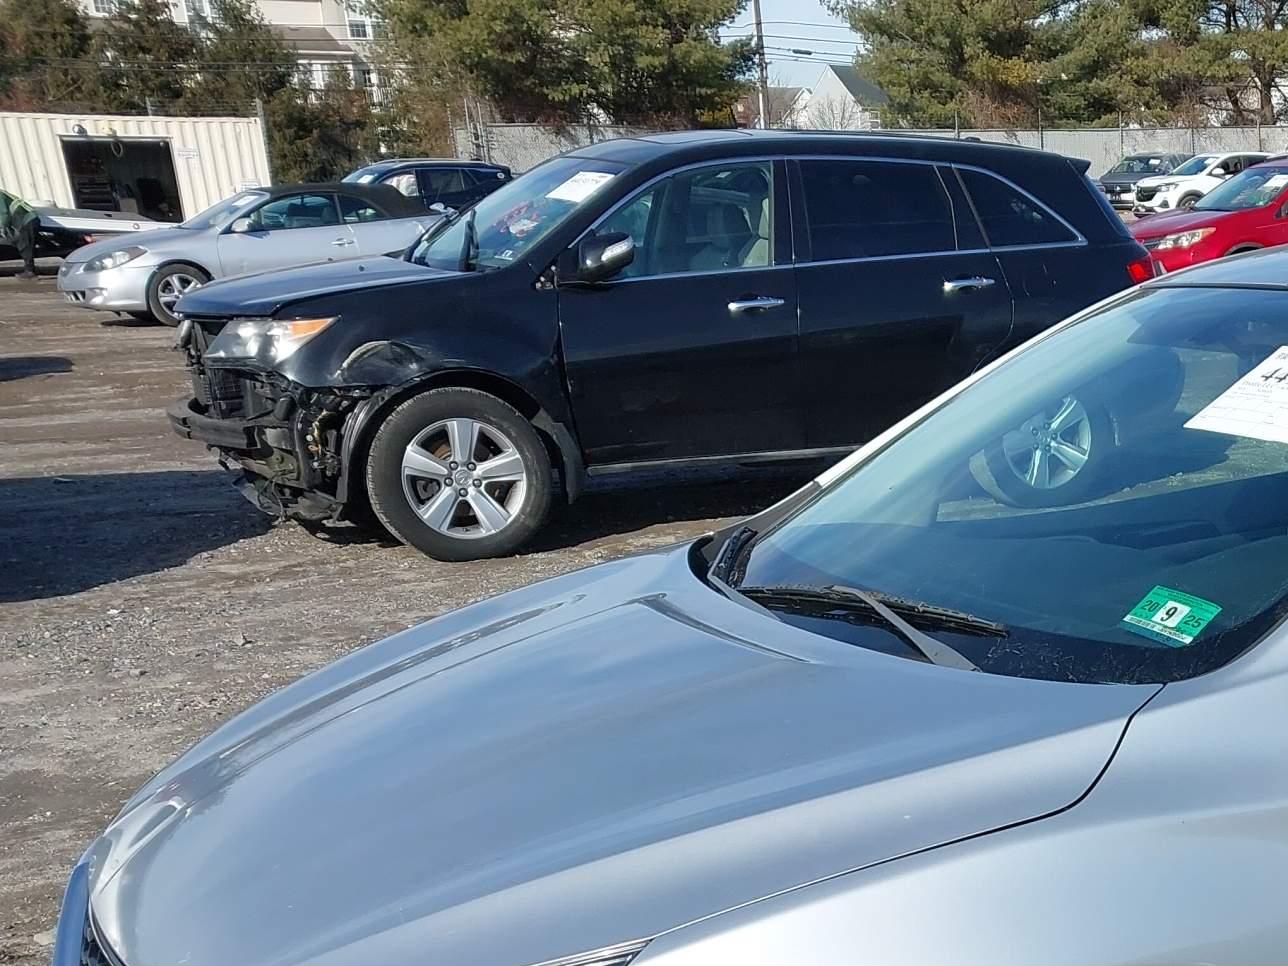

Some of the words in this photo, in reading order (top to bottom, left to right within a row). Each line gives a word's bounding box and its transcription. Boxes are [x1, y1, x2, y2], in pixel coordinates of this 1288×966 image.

[1141, 599, 1159, 613] 20
[1160, 606, 1178, 622] 9
[1183, 615, 1206, 629] 25
